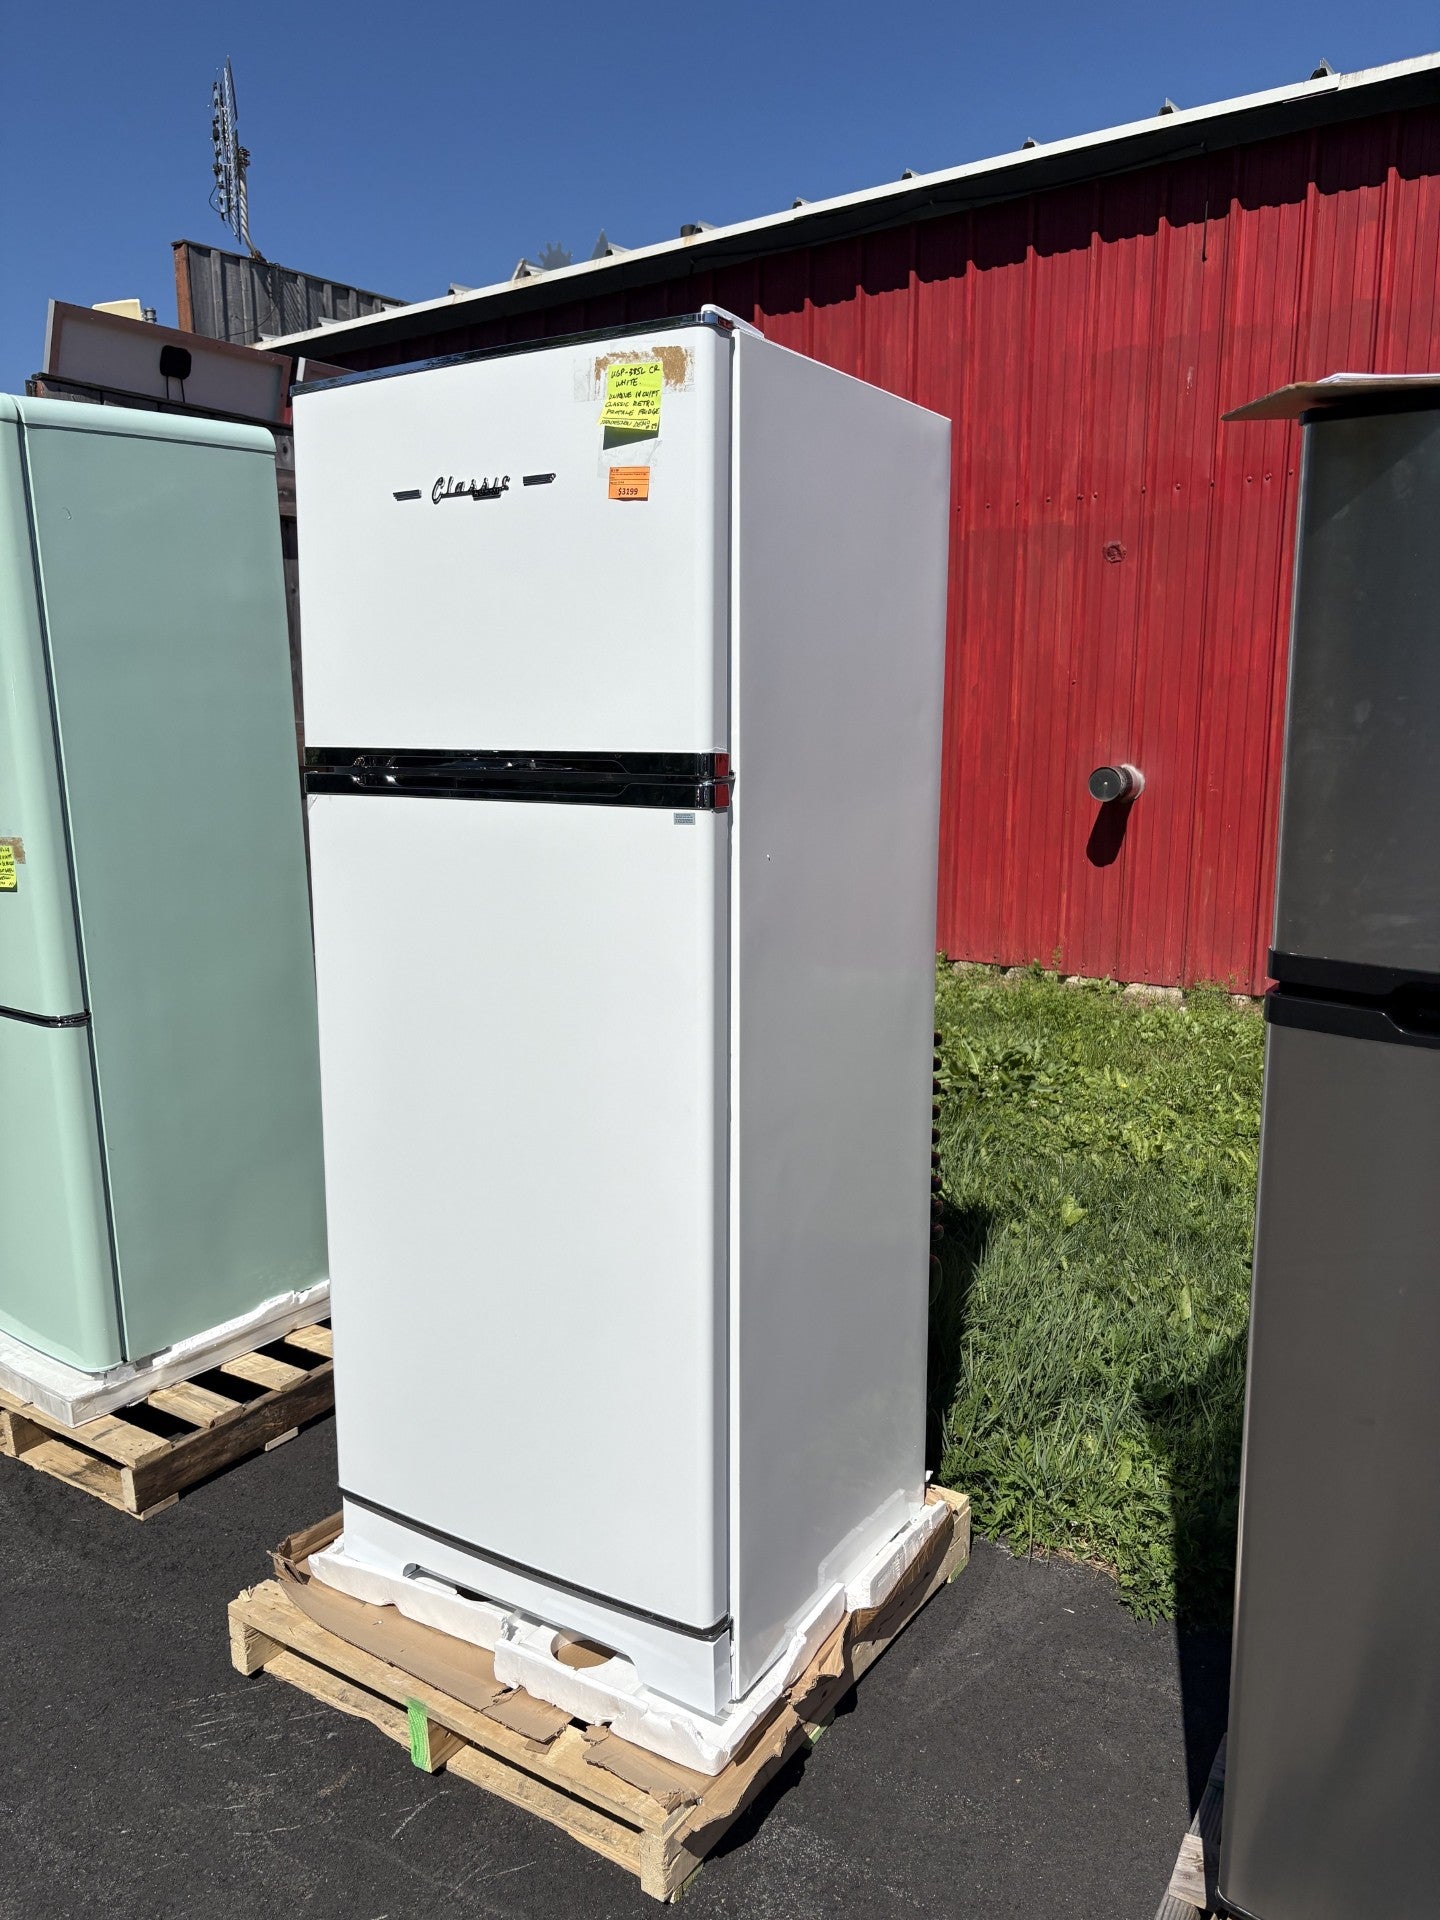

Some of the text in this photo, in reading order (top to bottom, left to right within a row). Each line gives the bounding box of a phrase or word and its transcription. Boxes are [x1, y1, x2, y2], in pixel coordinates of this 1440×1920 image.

[638, 407, 660, 415] FRIDGE
[432, 475, 511, 505] Classic
[618, 487, 639, 496] $3199
